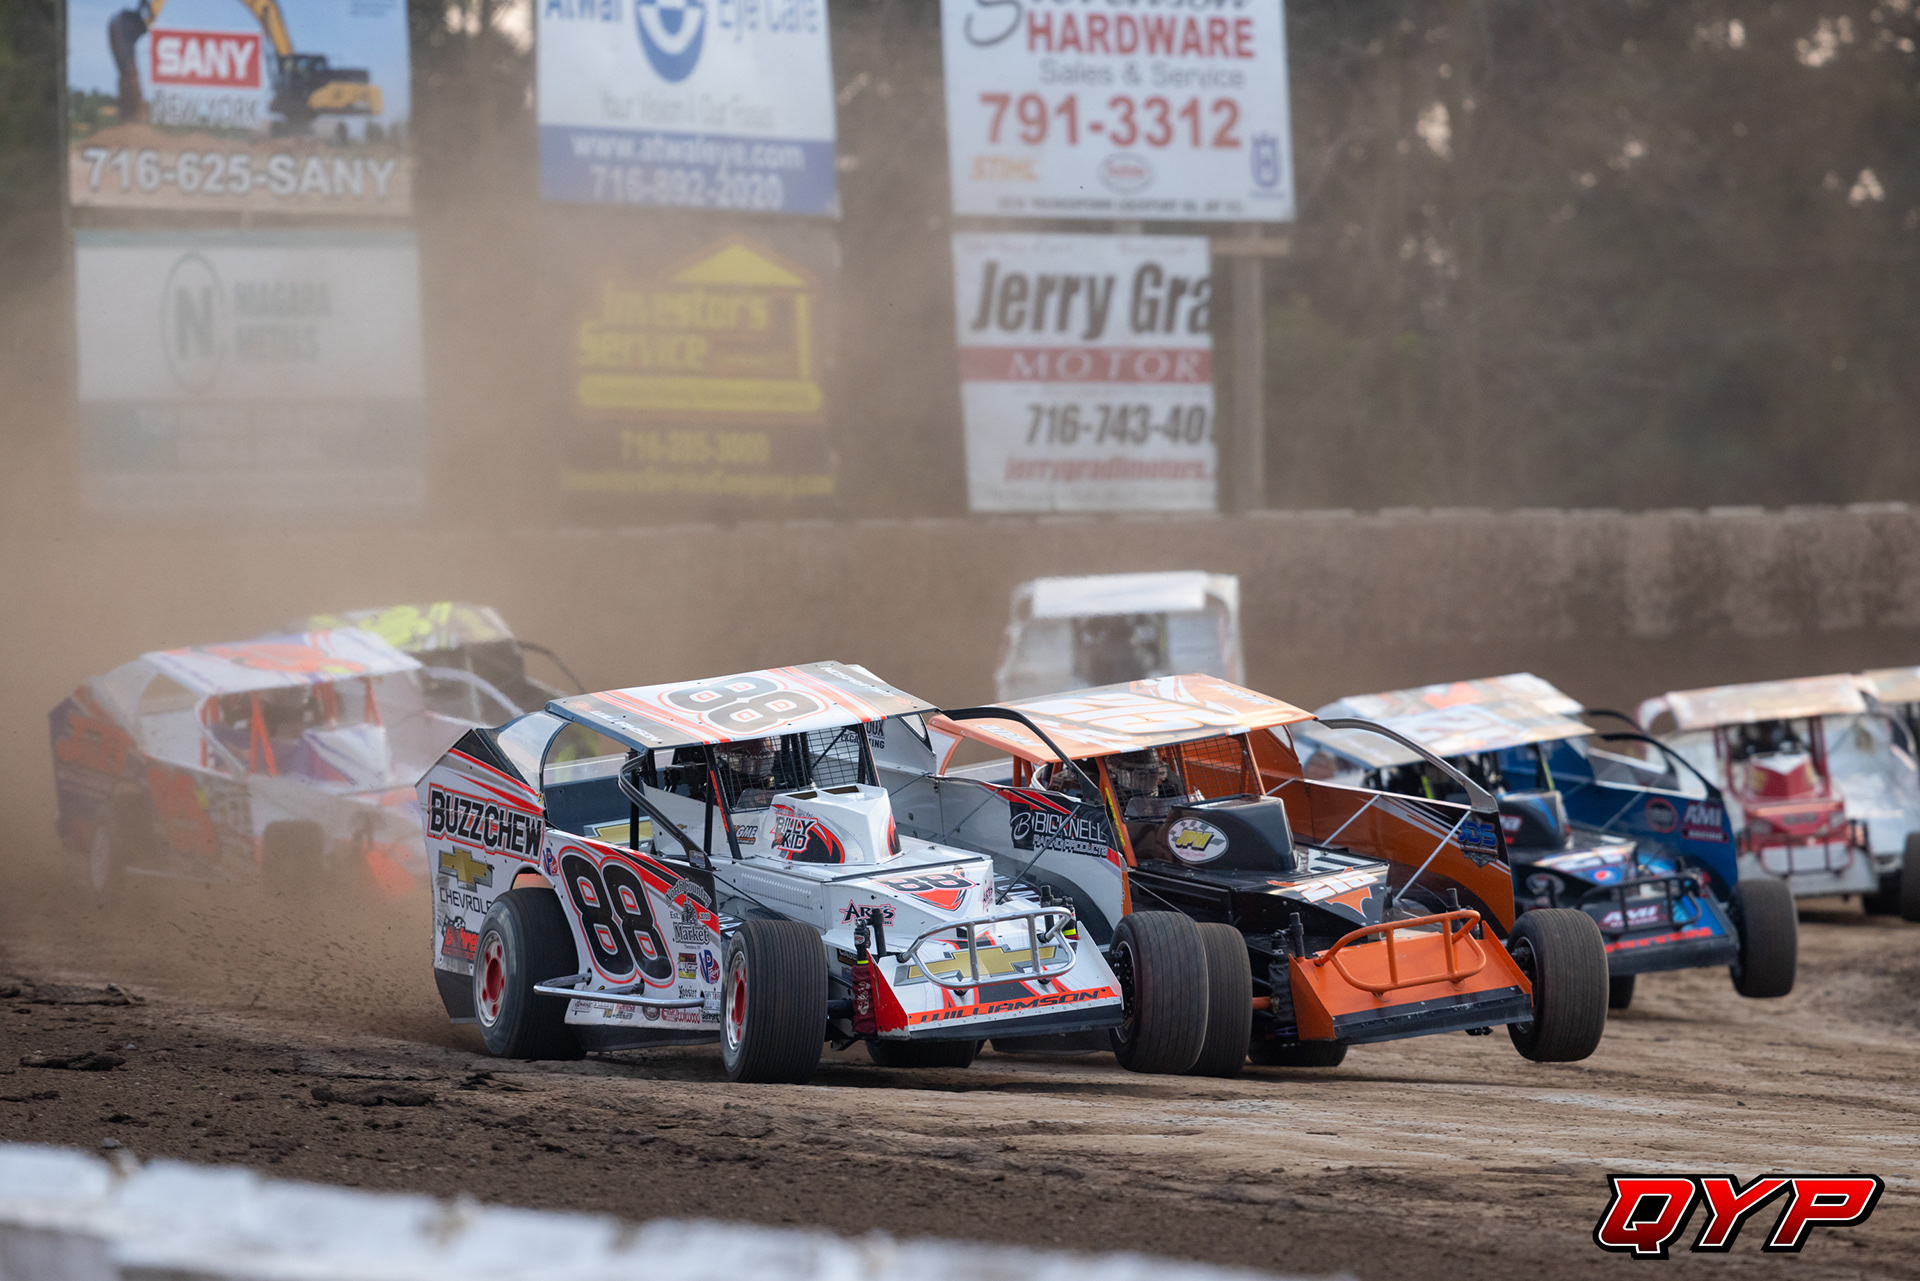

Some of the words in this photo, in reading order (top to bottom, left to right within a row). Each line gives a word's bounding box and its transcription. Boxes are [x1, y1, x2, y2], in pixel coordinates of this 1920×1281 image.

[1027, 11, 1256, 60] HARDWARE
[155, 36, 257, 81] SANY
[1039, 58, 1112, 86] Sales
[1122, 61, 1142, 86] &
[1151, 61, 1245, 89] Service
[208, 95, 259, 129] YORK
[979, 92, 1242, 149] 791-3312
[84, 148, 395, 197] 716-625-SANY
[971, 260, 1117, 340] Jerry
[174, 286, 214, 361] N
[1008, 351, 1202, 380] MOTOR
[1025, 404, 1213, 446] 716-743-40
[667, 676, 820, 734] 88
[775, 816, 815, 834] BILLY
[1034, 811, 1107, 843] BICKNELL
[1684, 804, 1722, 827] AMI
[780, 832, 807, 850] KID
[1033, 833, 1065, 852] RACING
[1065, 838, 1108, 857] PRODUCTS
[1176, 829, 1213, 849] JPM
[1459, 820, 1497, 848] JDS
[664, 878, 686, 908] North
[685, 877, 713, 909] Country
[878, 872, 975, 893] 88
[440, 886, 493, 915] CHEVROLE
[1603, 904, 1660, 924] AMI
[561, 854, 674, 980] 88
[673, 924, 710, 944] Market
[699, 950, 713, 984] VP
[920, 990, 1100, 1024] WILLIAMSON
